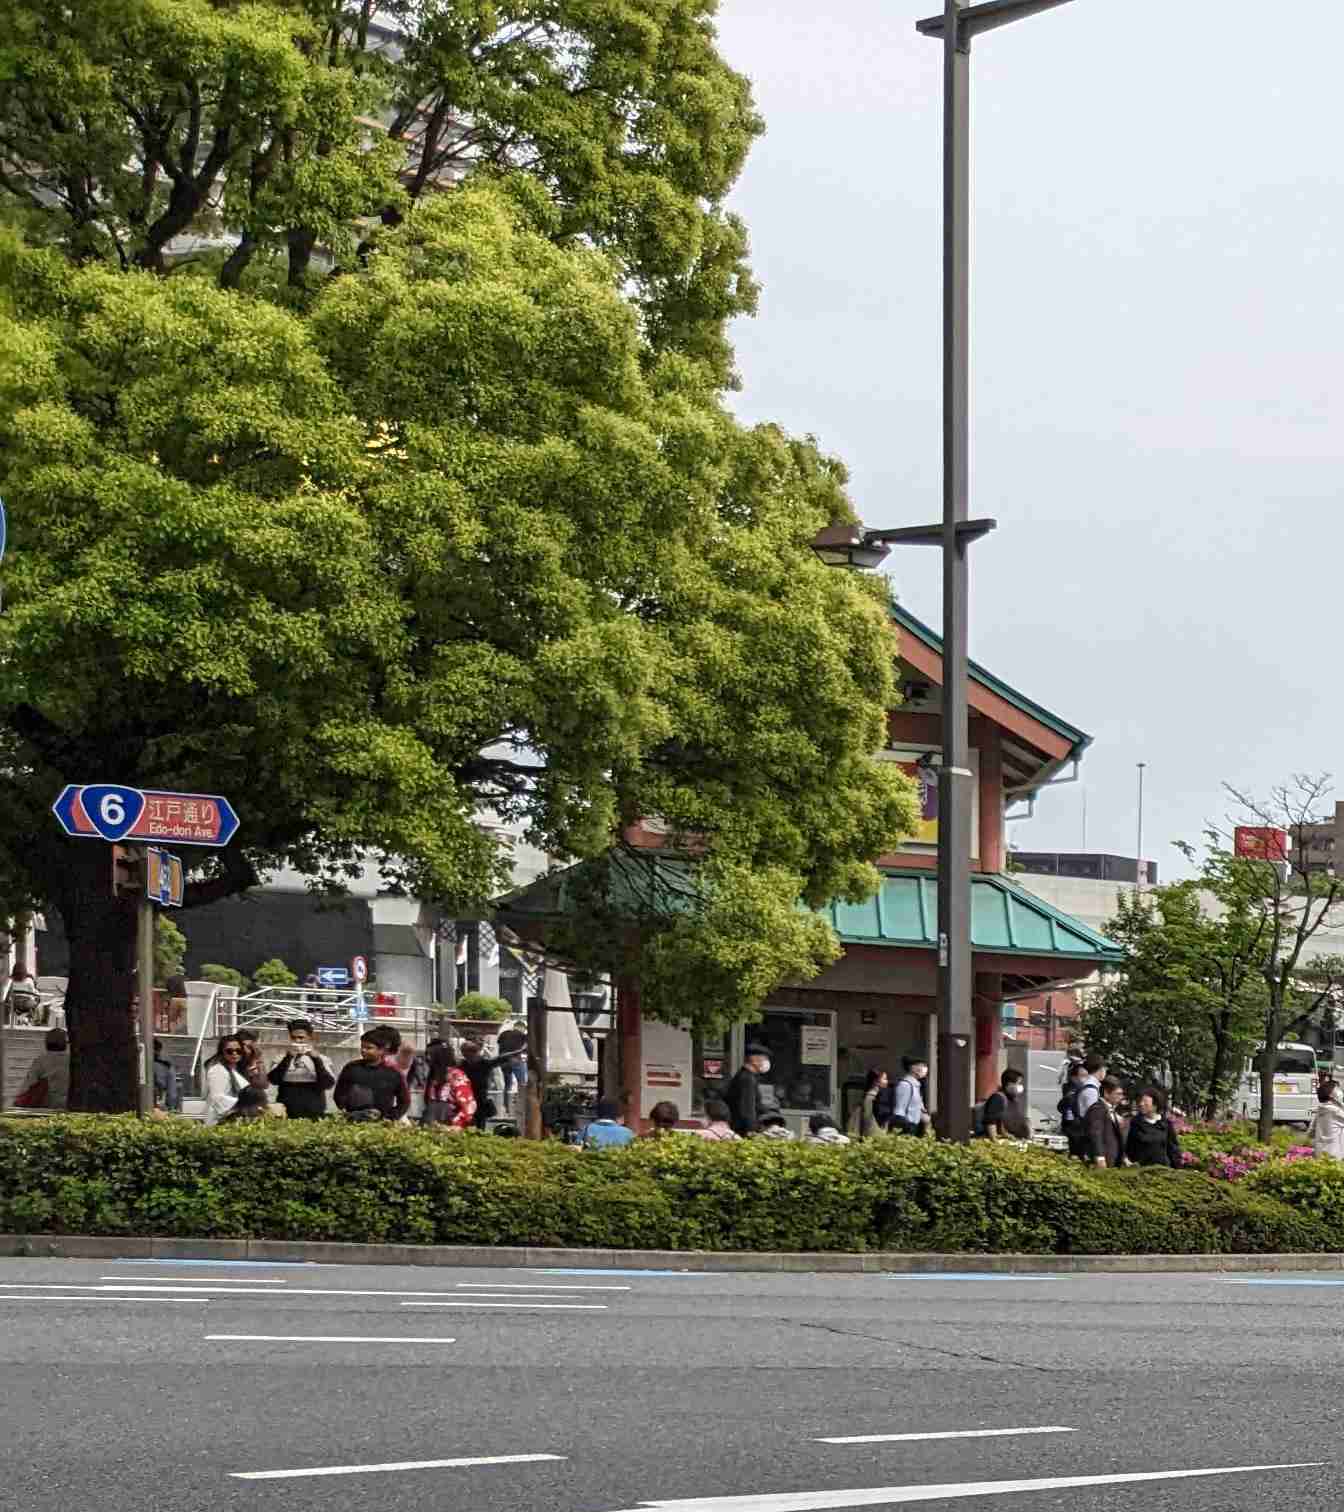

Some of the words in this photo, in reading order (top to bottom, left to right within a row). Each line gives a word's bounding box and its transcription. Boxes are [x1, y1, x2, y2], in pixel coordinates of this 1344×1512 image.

[101, 794, 125, 825] 6
[149, 799, 214, 824] 江戸通り
[150, 822, 193, 838] Edo-dori
